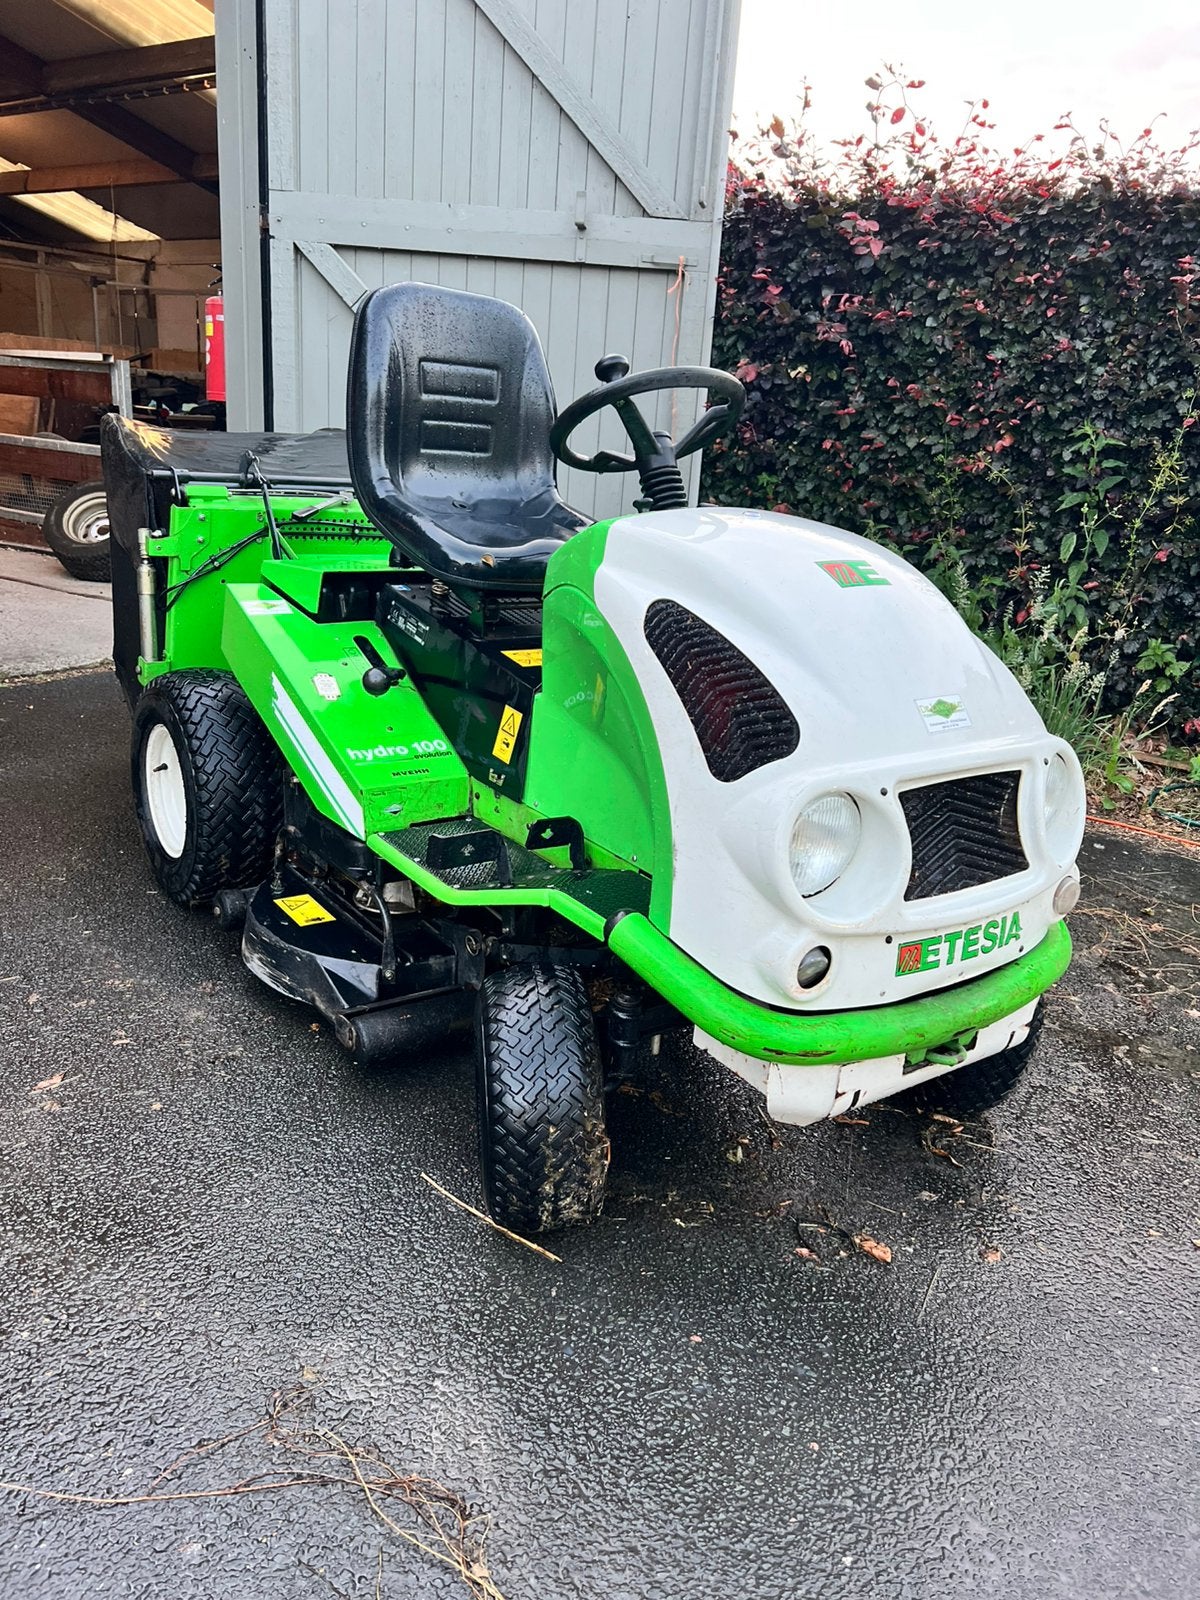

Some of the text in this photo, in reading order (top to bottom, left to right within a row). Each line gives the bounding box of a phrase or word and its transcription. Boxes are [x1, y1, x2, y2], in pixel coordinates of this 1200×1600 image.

[346, 739, 447, 761] hydro 100
[413, 750, 453, 760] evolution
[919, 911, 1022, 971] ETESIA
